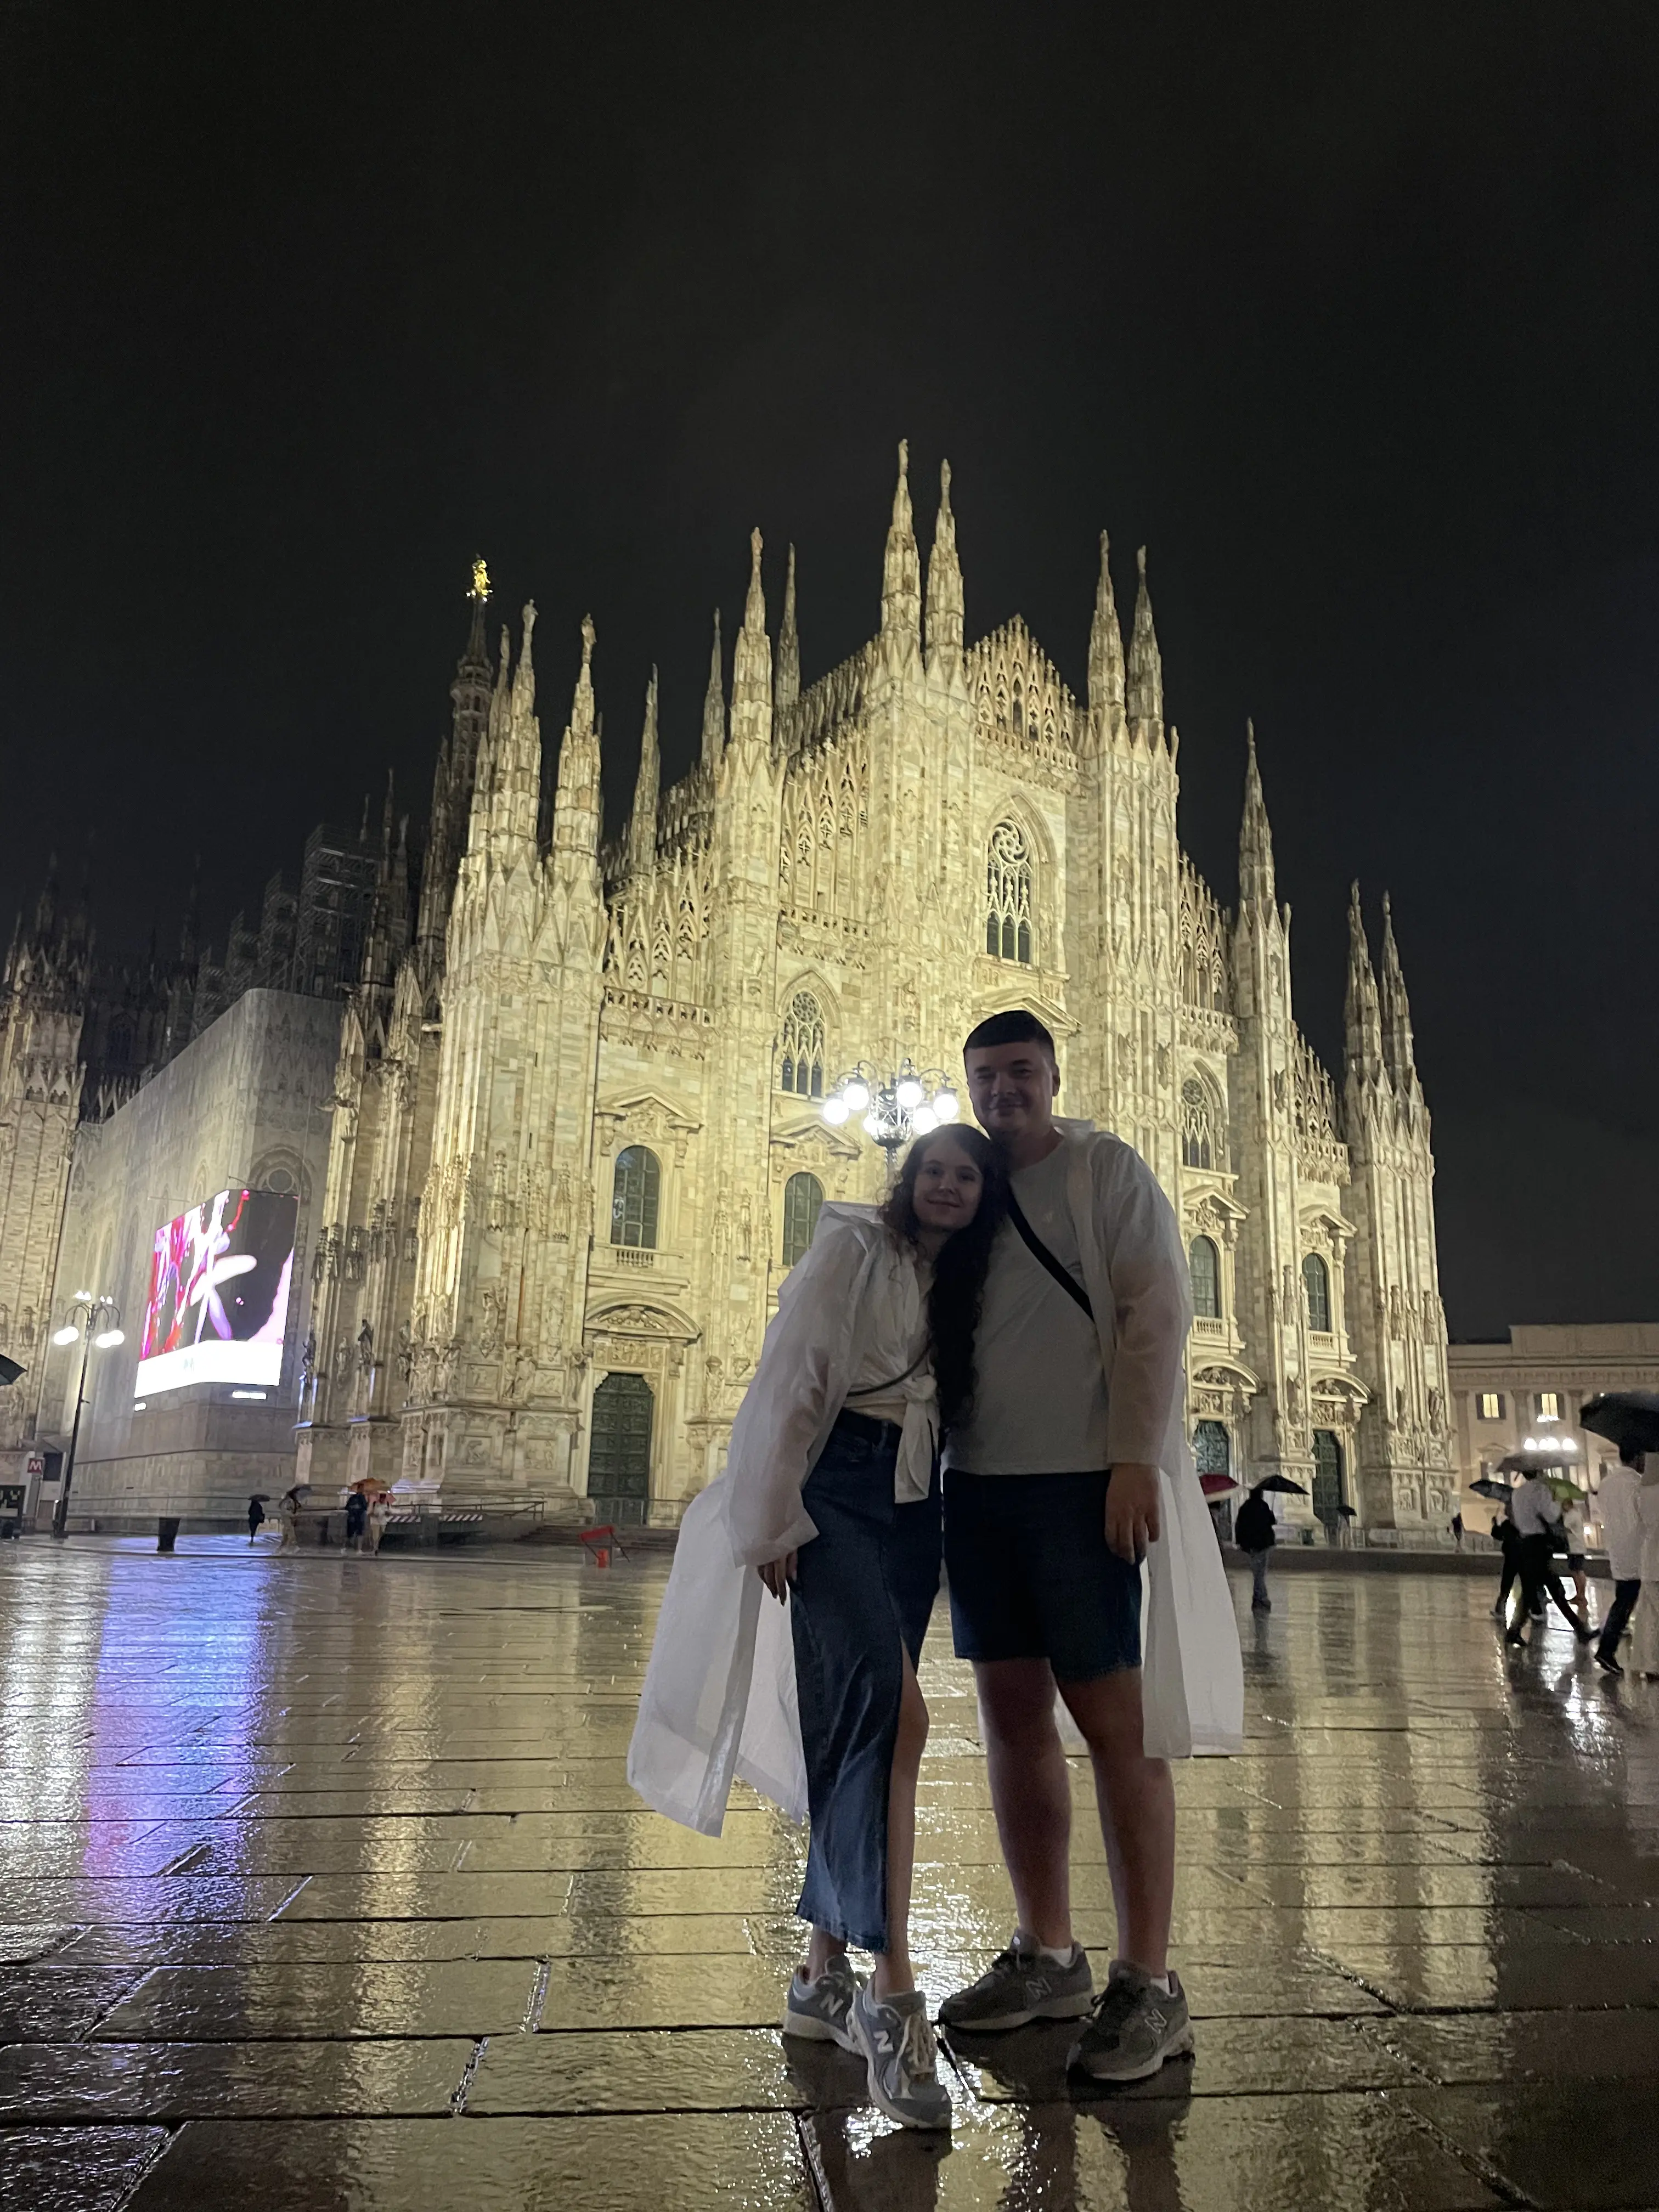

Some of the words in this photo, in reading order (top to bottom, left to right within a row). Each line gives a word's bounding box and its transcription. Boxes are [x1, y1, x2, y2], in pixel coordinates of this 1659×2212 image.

[29, 1461, 42, 1470] M
[1026, 1977, 1052, 2000] N
[819, 1993, 844, 2017] N
[1144, 2008, 1167, 2034] N
[873, 2030, 894, 2053] N
